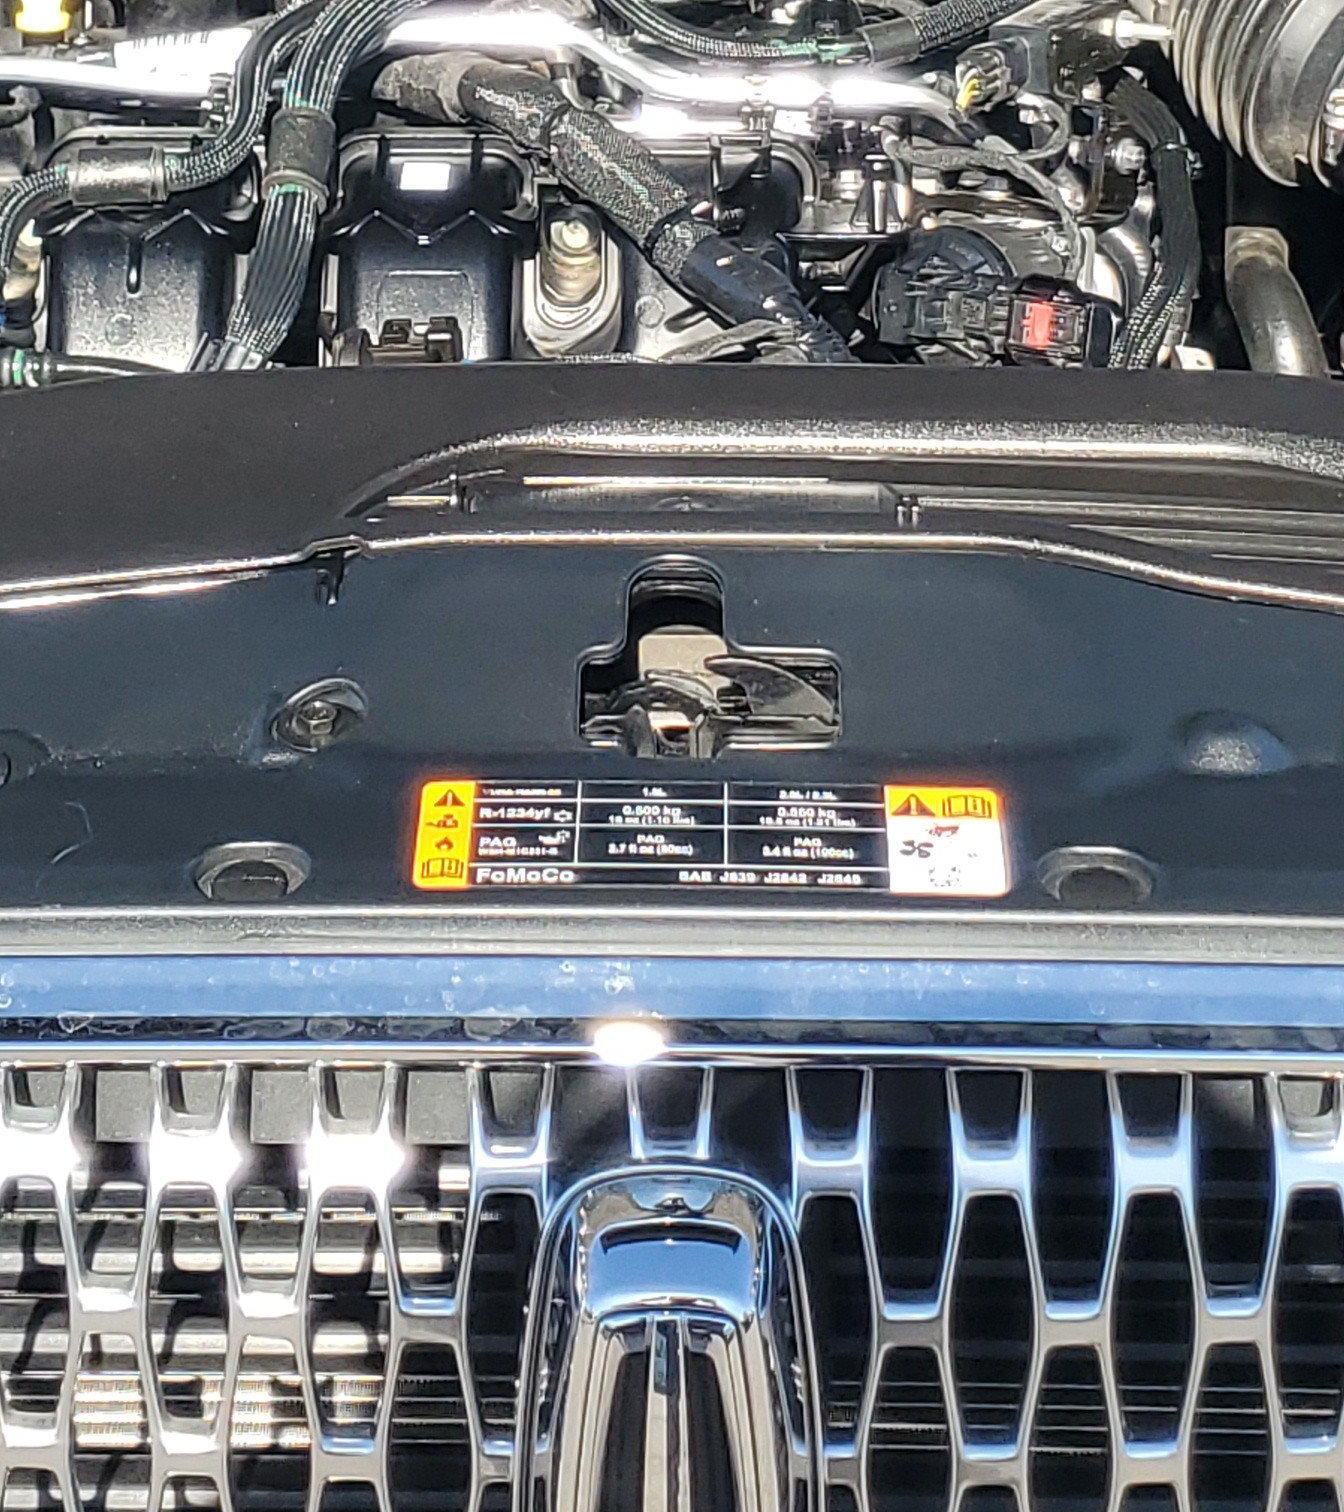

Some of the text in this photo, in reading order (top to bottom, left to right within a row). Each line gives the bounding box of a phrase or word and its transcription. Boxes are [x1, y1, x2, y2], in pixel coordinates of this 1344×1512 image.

[479, 807, 552, 820] R-1234yf
[479, 836, 517, 847] PAG
[476, 868, 575, 884] FoMoCo
